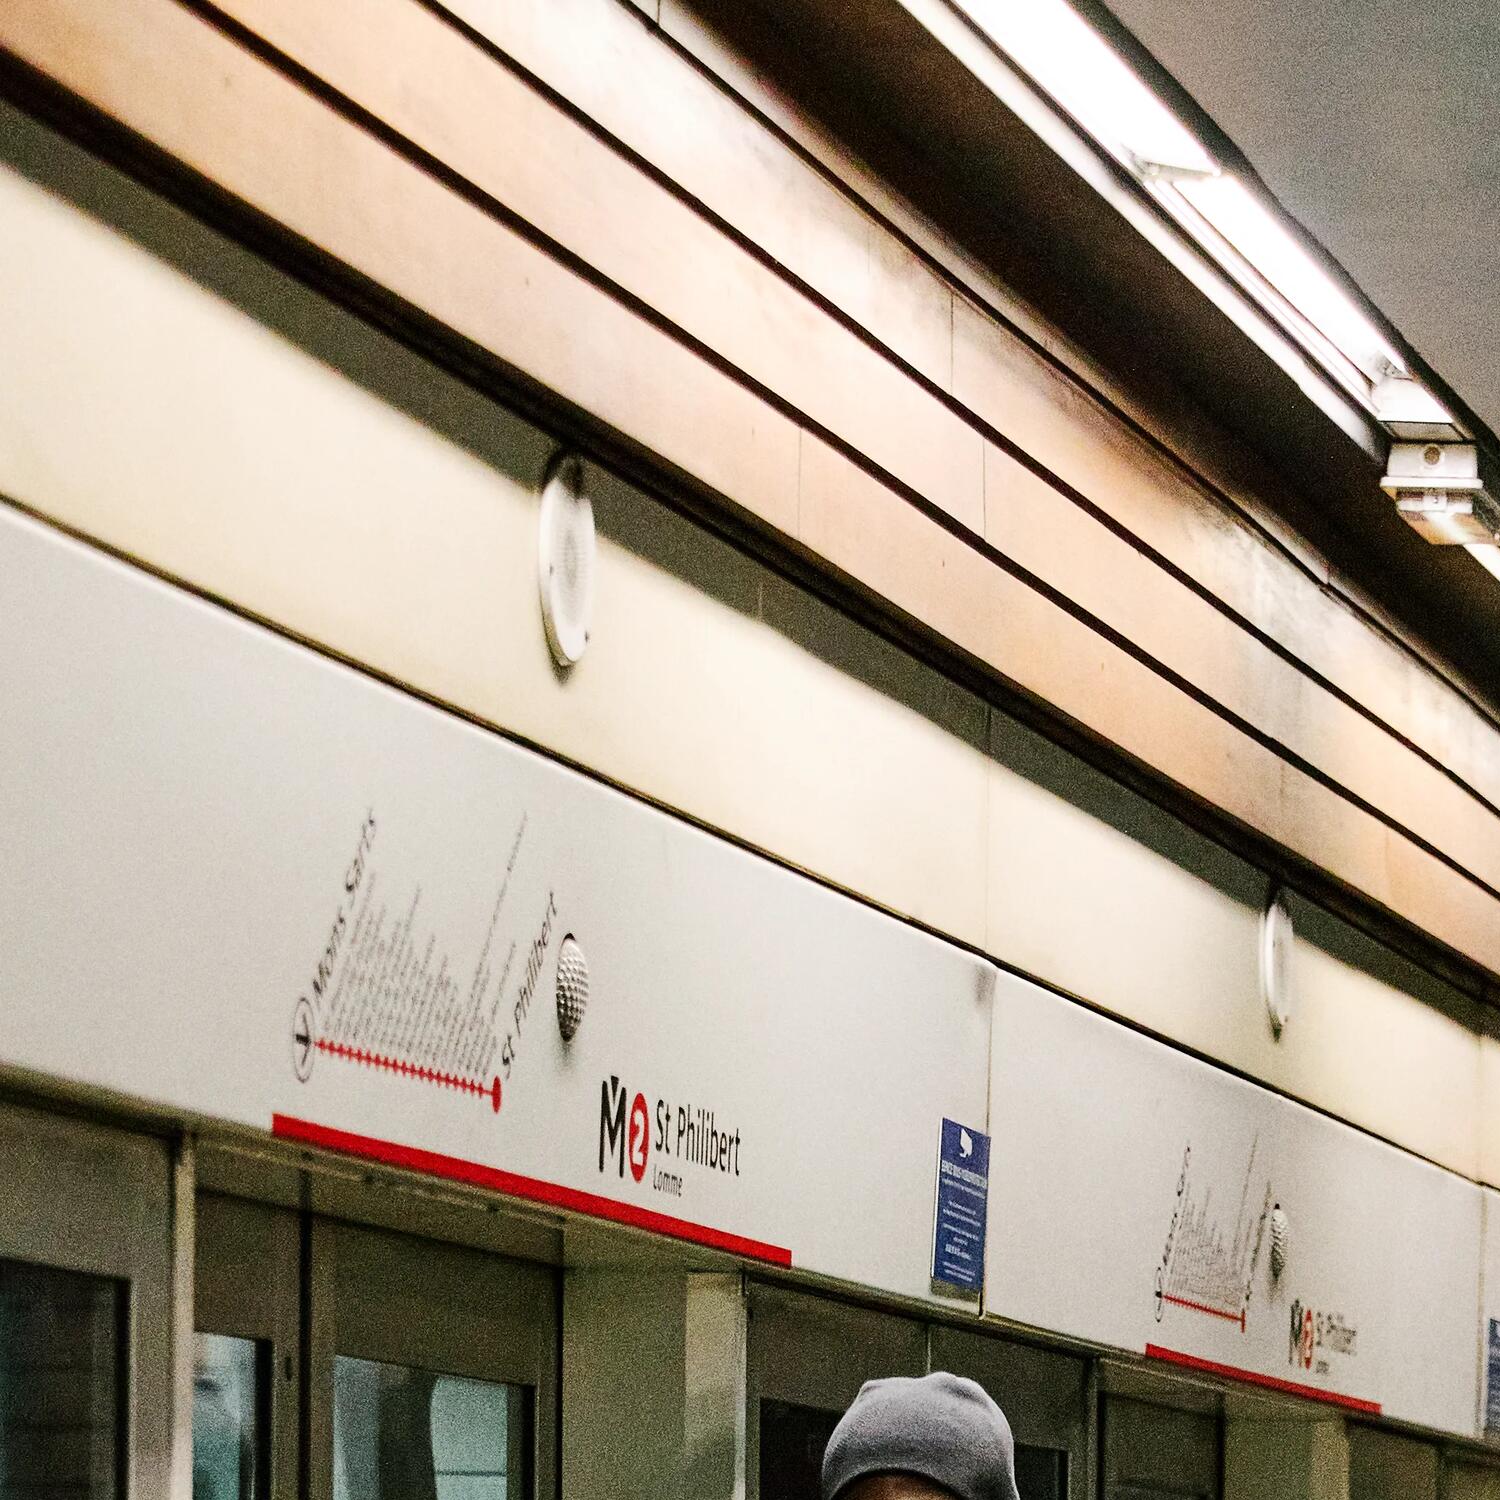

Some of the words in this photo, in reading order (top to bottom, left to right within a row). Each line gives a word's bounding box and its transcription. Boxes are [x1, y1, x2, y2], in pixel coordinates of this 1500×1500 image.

[502, 1034, 515, 1080] St
[514, 890, 556, 1038] Philibert
[655, 1099, 671, 1154] St
[677, 1103, 740, 1176] Philibert
[653, 1163, 683, 1198] Lomme
